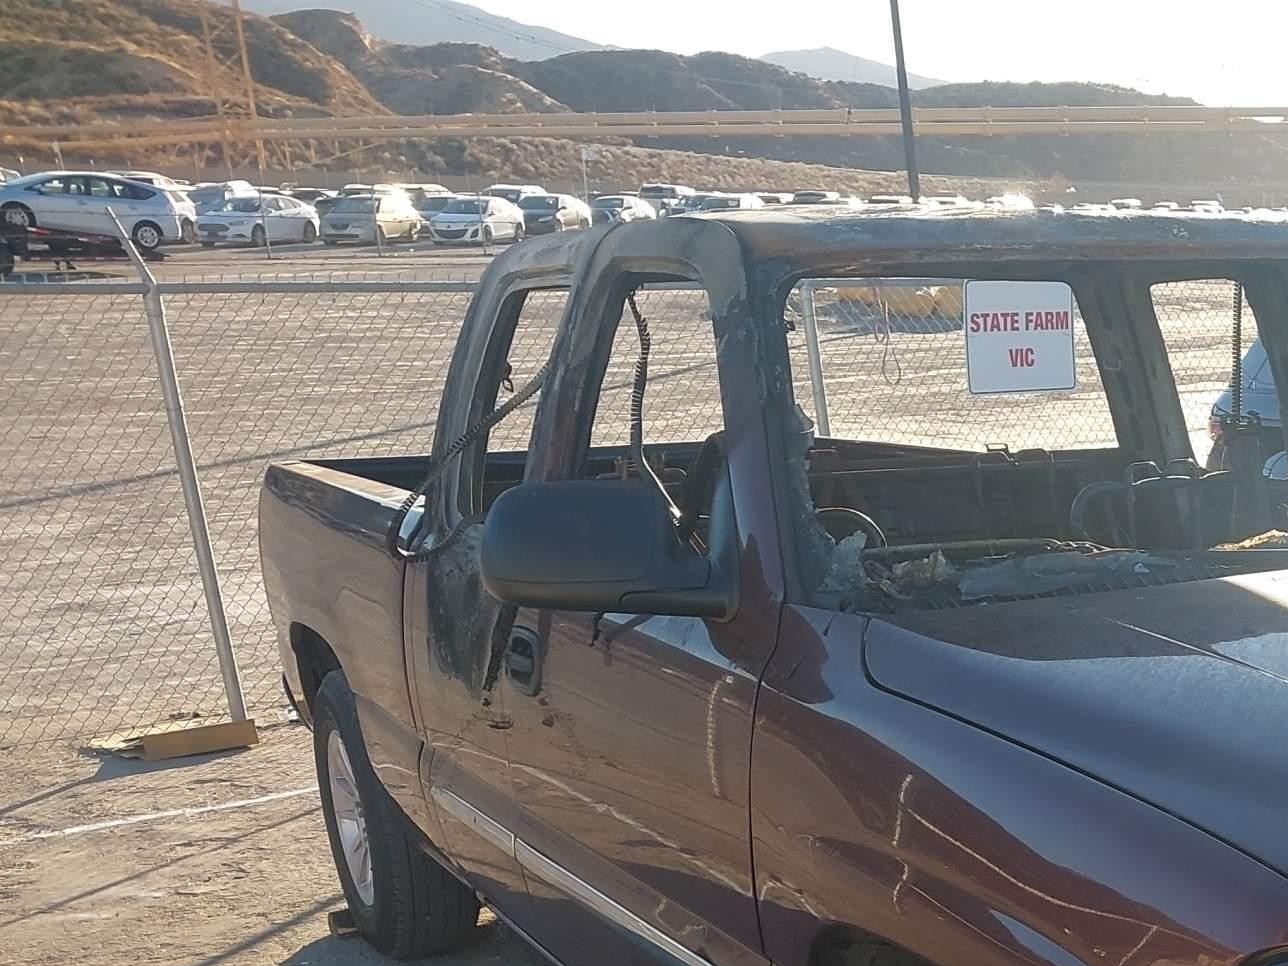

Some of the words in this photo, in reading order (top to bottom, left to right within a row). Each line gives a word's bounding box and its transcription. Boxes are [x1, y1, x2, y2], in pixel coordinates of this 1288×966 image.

[970, 312, 1019, 332] STATE
[1025, 311, 1069, 331] FARM
[1008, 348, 1034, 367] VIC
